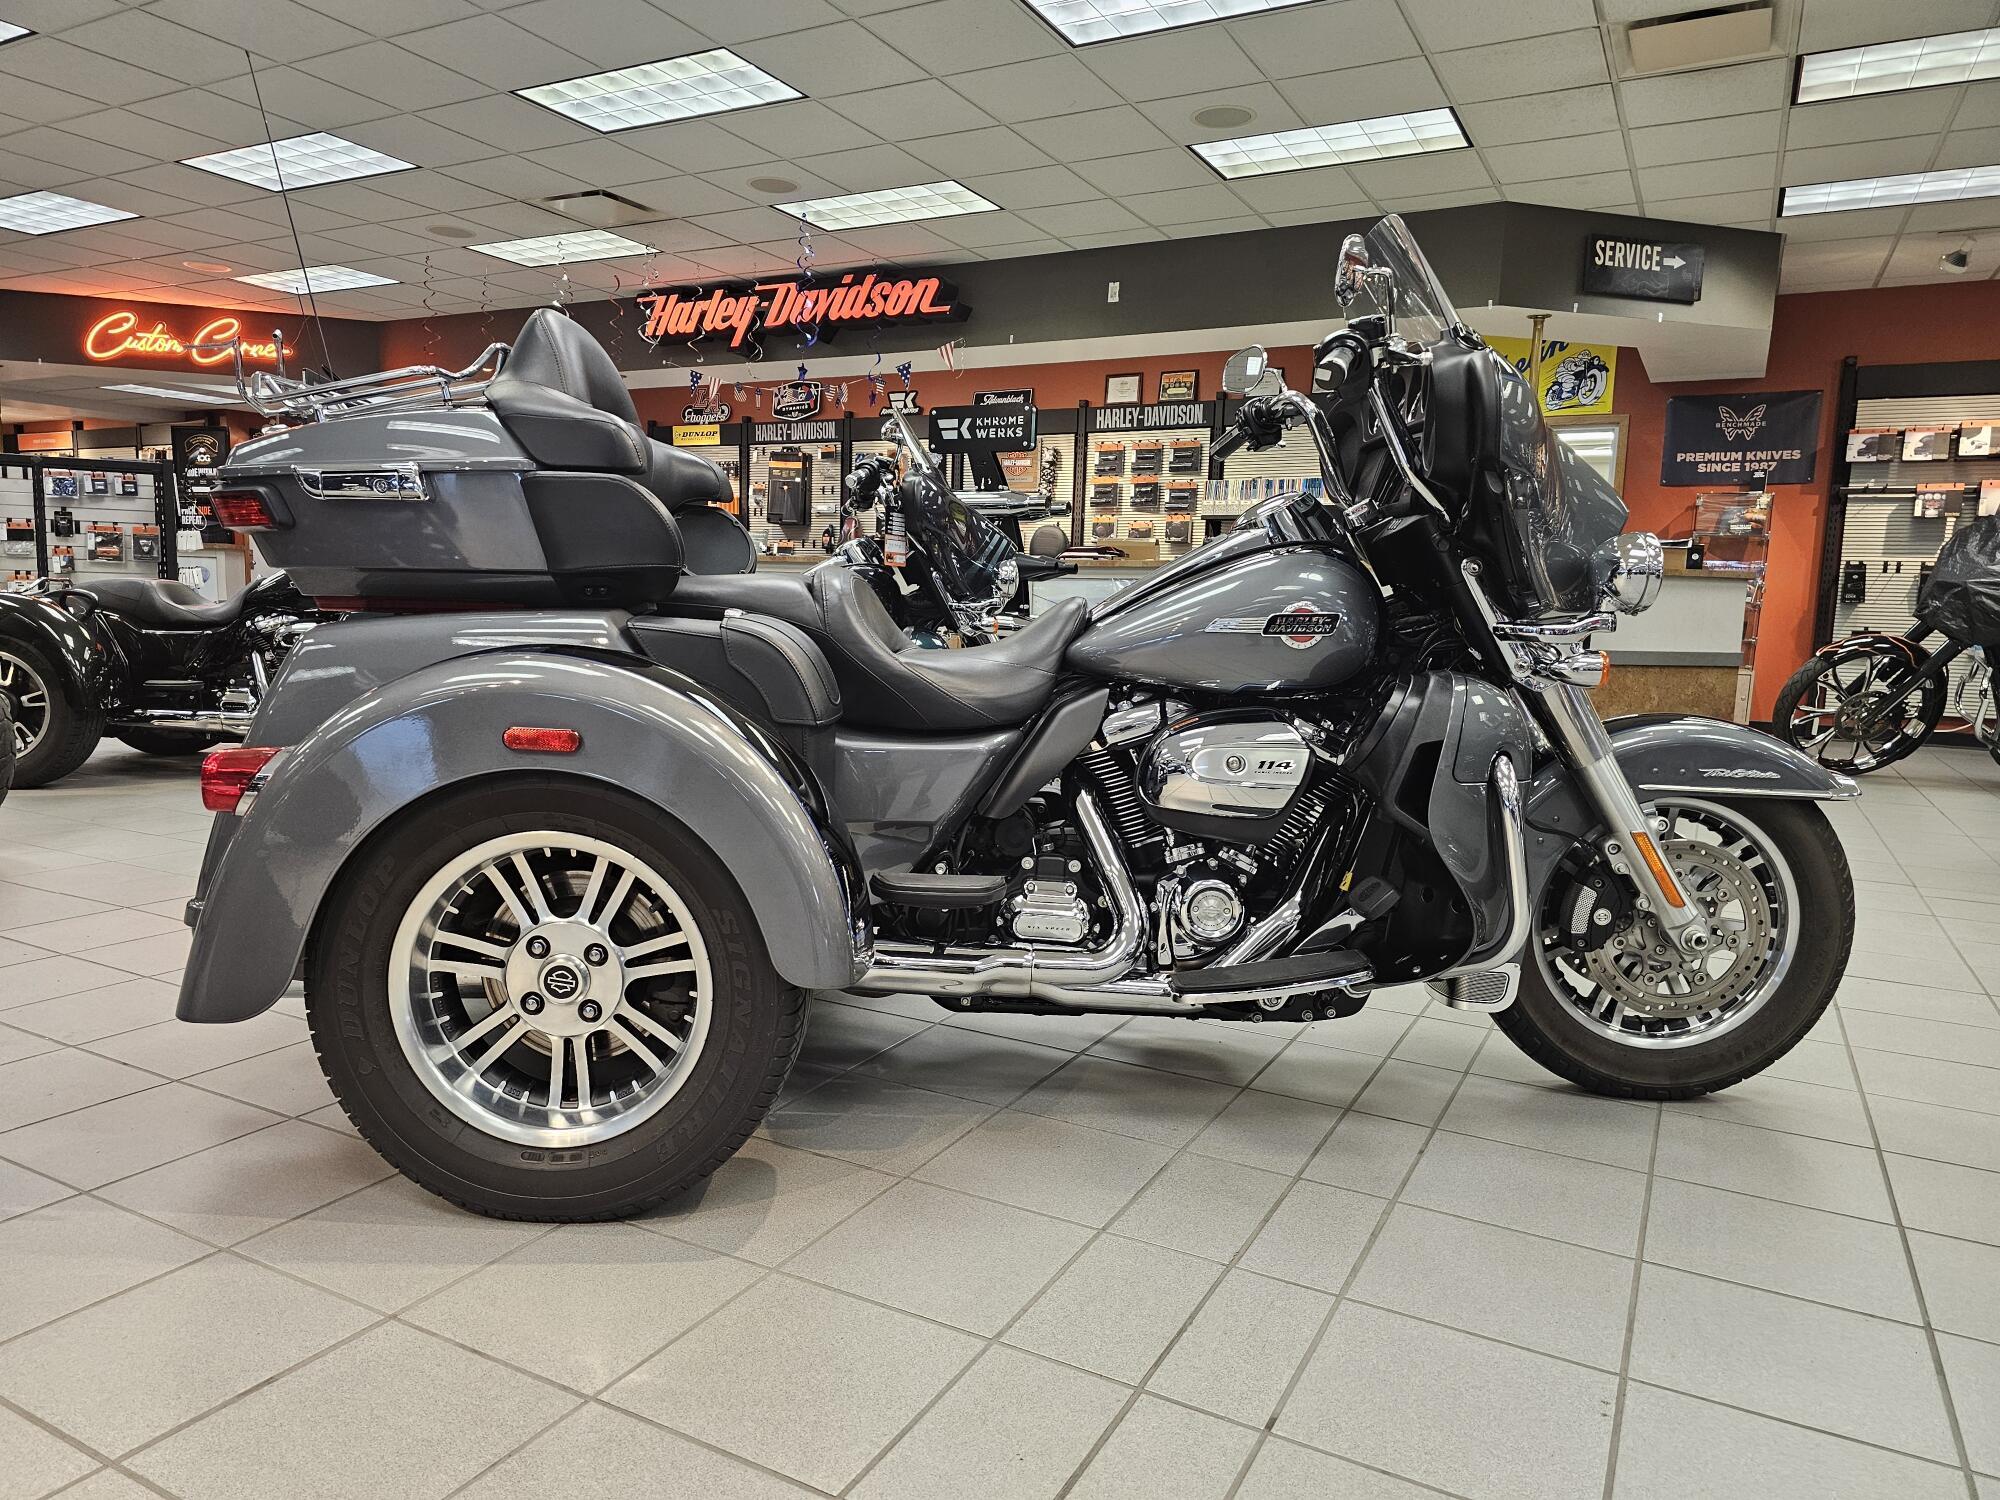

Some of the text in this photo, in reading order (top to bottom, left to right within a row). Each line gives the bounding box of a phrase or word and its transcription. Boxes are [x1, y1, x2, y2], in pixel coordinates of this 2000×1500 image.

[1594, 239, 1662, 272] SERVICE
[637, 273, 951, 348] Harley-Davidson
[86, 311, 185, 359] Custom
[684, 408, 726, 424] Choppers
[976, 415, 1024, 427] KHROME
[1096, 403, 1204, 429] HARLEY-DAVIDSON
[755, 421, 836, 442] HARLEY-DAVIDSON
[1715, 420, 1767, 429] BENCHMADE
[682, 430, 718, 438] DUNLOP
[975, 427, 1023, 439] WERKS
[1676, 449, 1802, 463] PREMIUM KNIVES
[1697, 461, 1778, 473] SINCE 1987
[1268, 624, 1332, 633] DAVIDSON
[1257, 760, 1293, 770] 114
[337, 854, 396, 1041] DUNLOP
[656, 908, 753, 1165] SIGNATURE
